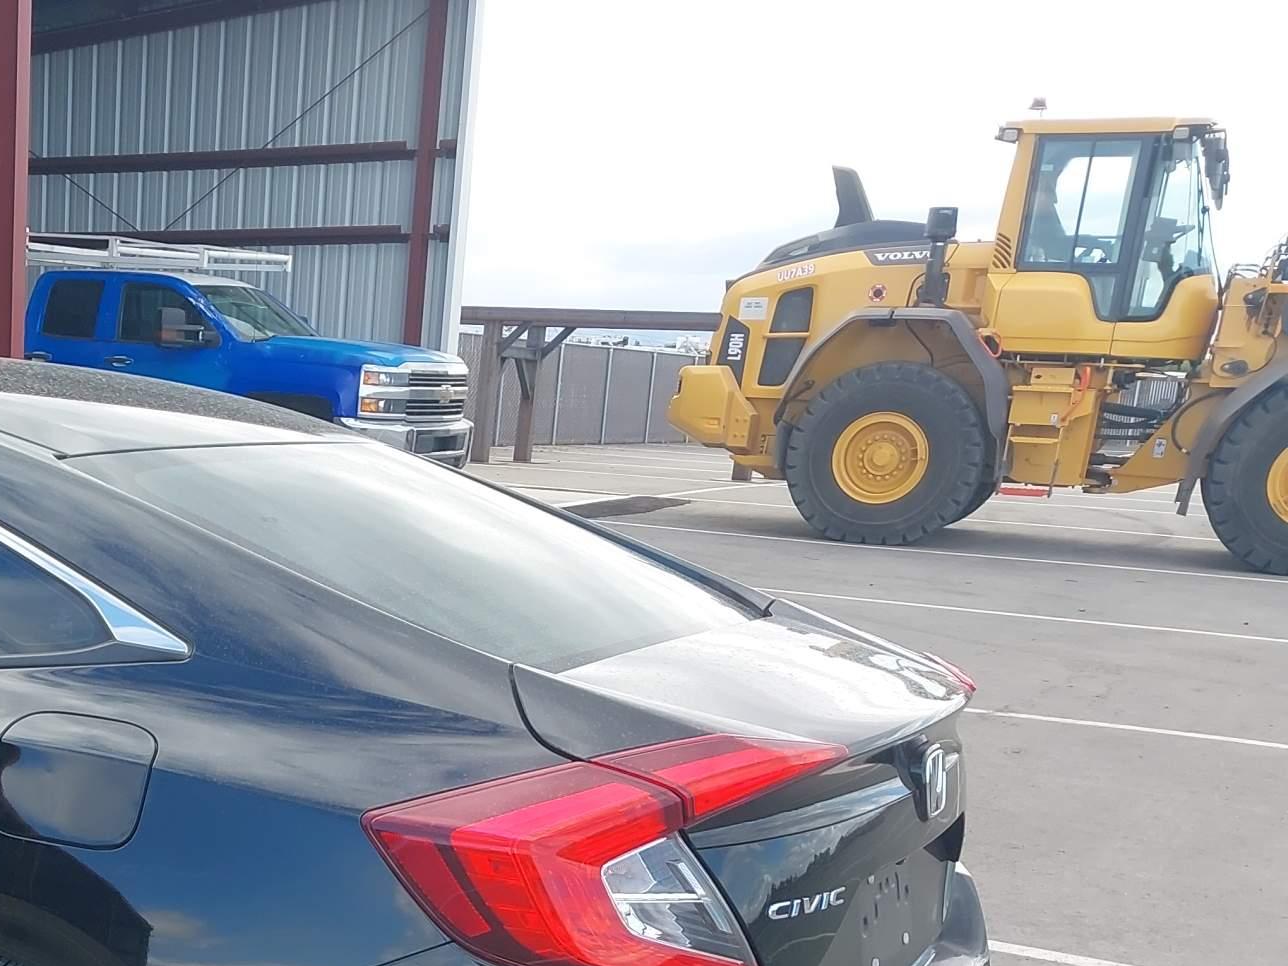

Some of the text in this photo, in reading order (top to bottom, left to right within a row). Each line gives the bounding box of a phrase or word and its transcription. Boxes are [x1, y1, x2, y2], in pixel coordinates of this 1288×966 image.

[873, 250, 931, 261] VOLV
[726, 333, 745, 361] L90H
[768, 886, 846, 920] CIVIC
